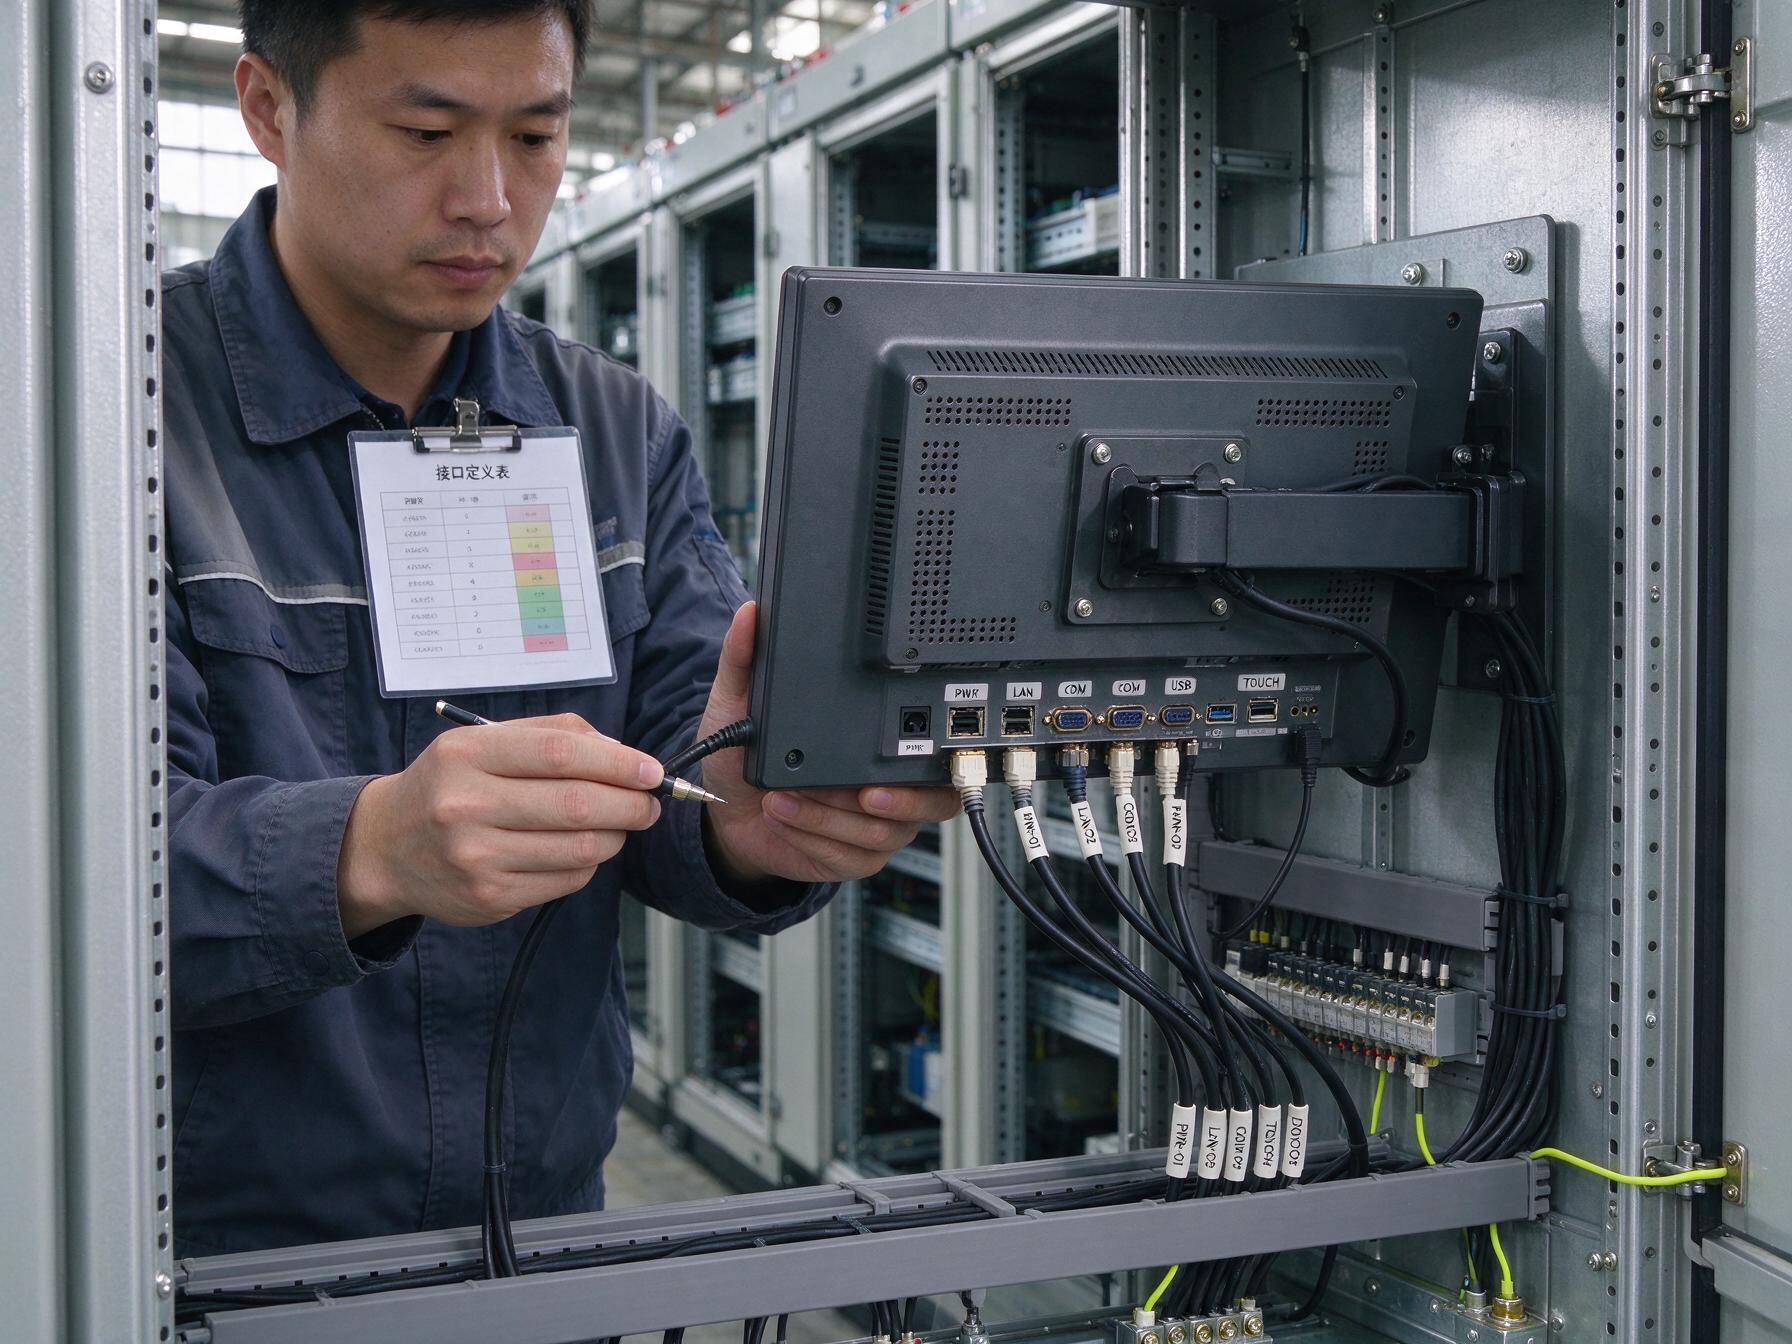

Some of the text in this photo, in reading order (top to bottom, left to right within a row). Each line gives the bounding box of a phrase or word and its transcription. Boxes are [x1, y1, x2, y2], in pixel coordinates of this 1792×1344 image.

[436, 463, 511, 481] 接口定义表
[1171, 679, 1192, 691] USB
[1243, 677, 1280, 689] TOUCH
[1013, 686, 1034, 698] LAN
